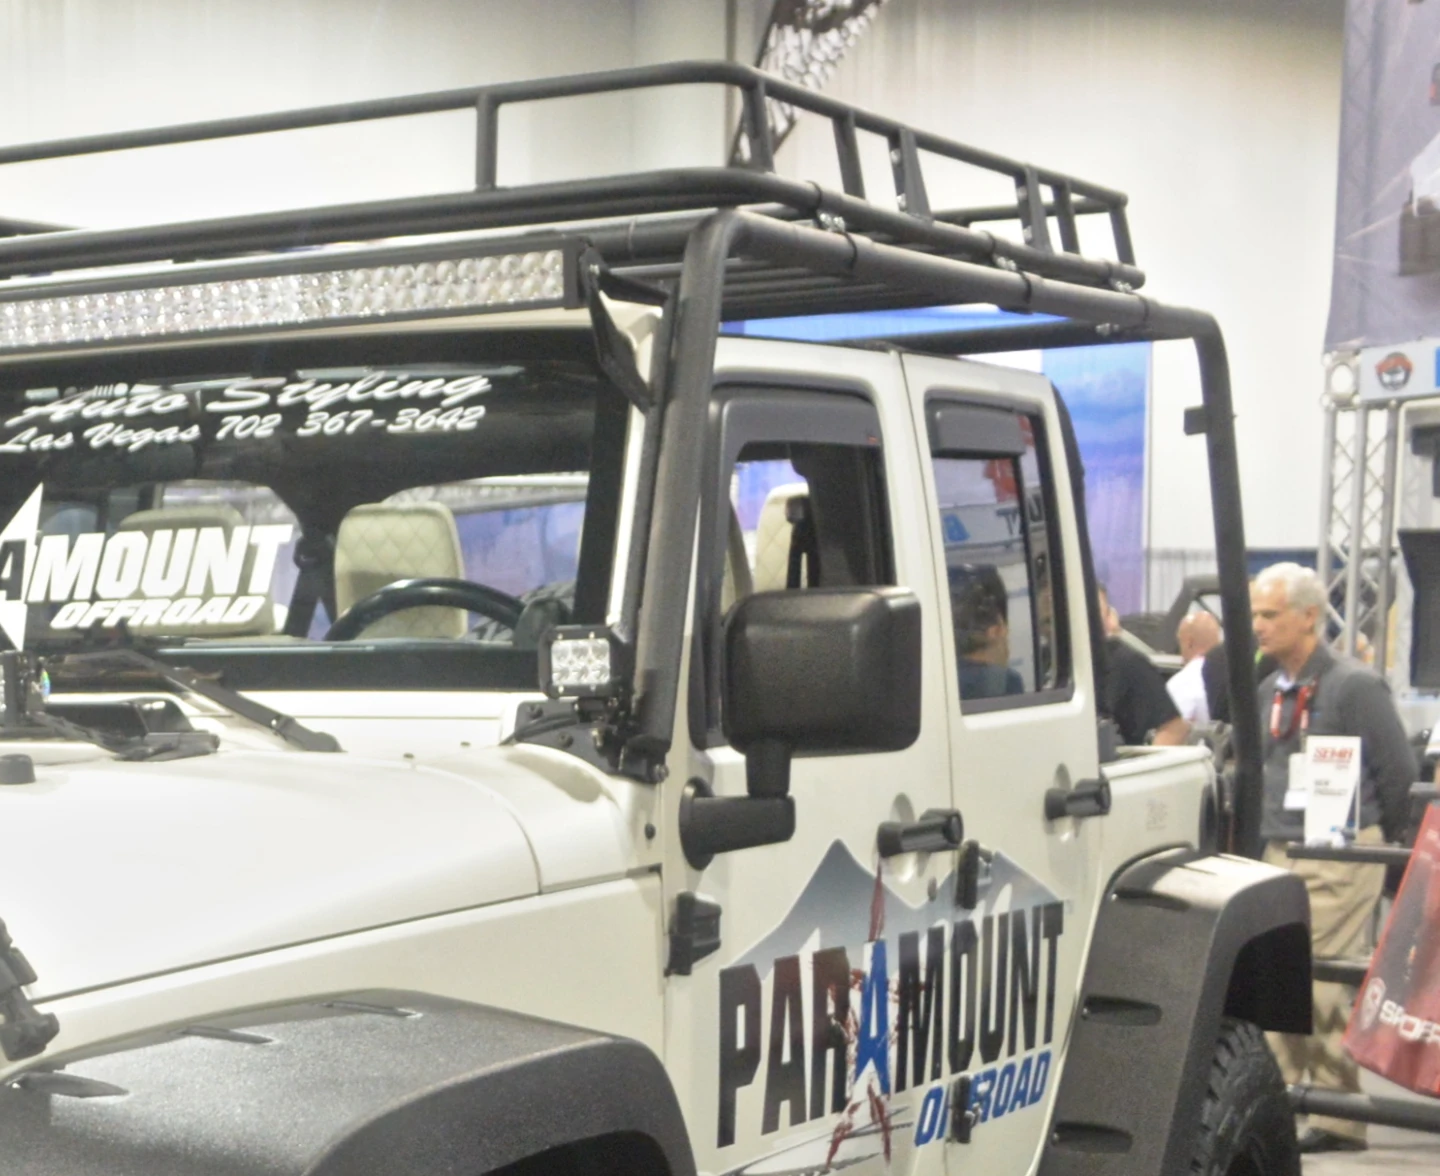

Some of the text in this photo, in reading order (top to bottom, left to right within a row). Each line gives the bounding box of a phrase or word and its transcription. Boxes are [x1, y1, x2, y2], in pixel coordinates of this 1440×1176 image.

[6, 373, 492, 427] Auto Styling
[82, 421, 201, 452] Vegas
[215, 414, 284, 441] 702
[296, 405, 486, 438] 367-3642
[51, 597, 264, 628] OFFROAD
[716, 902, 1063, 1149] PARAMOUNT
[914, 1049, 1052, 1148] OROAD
